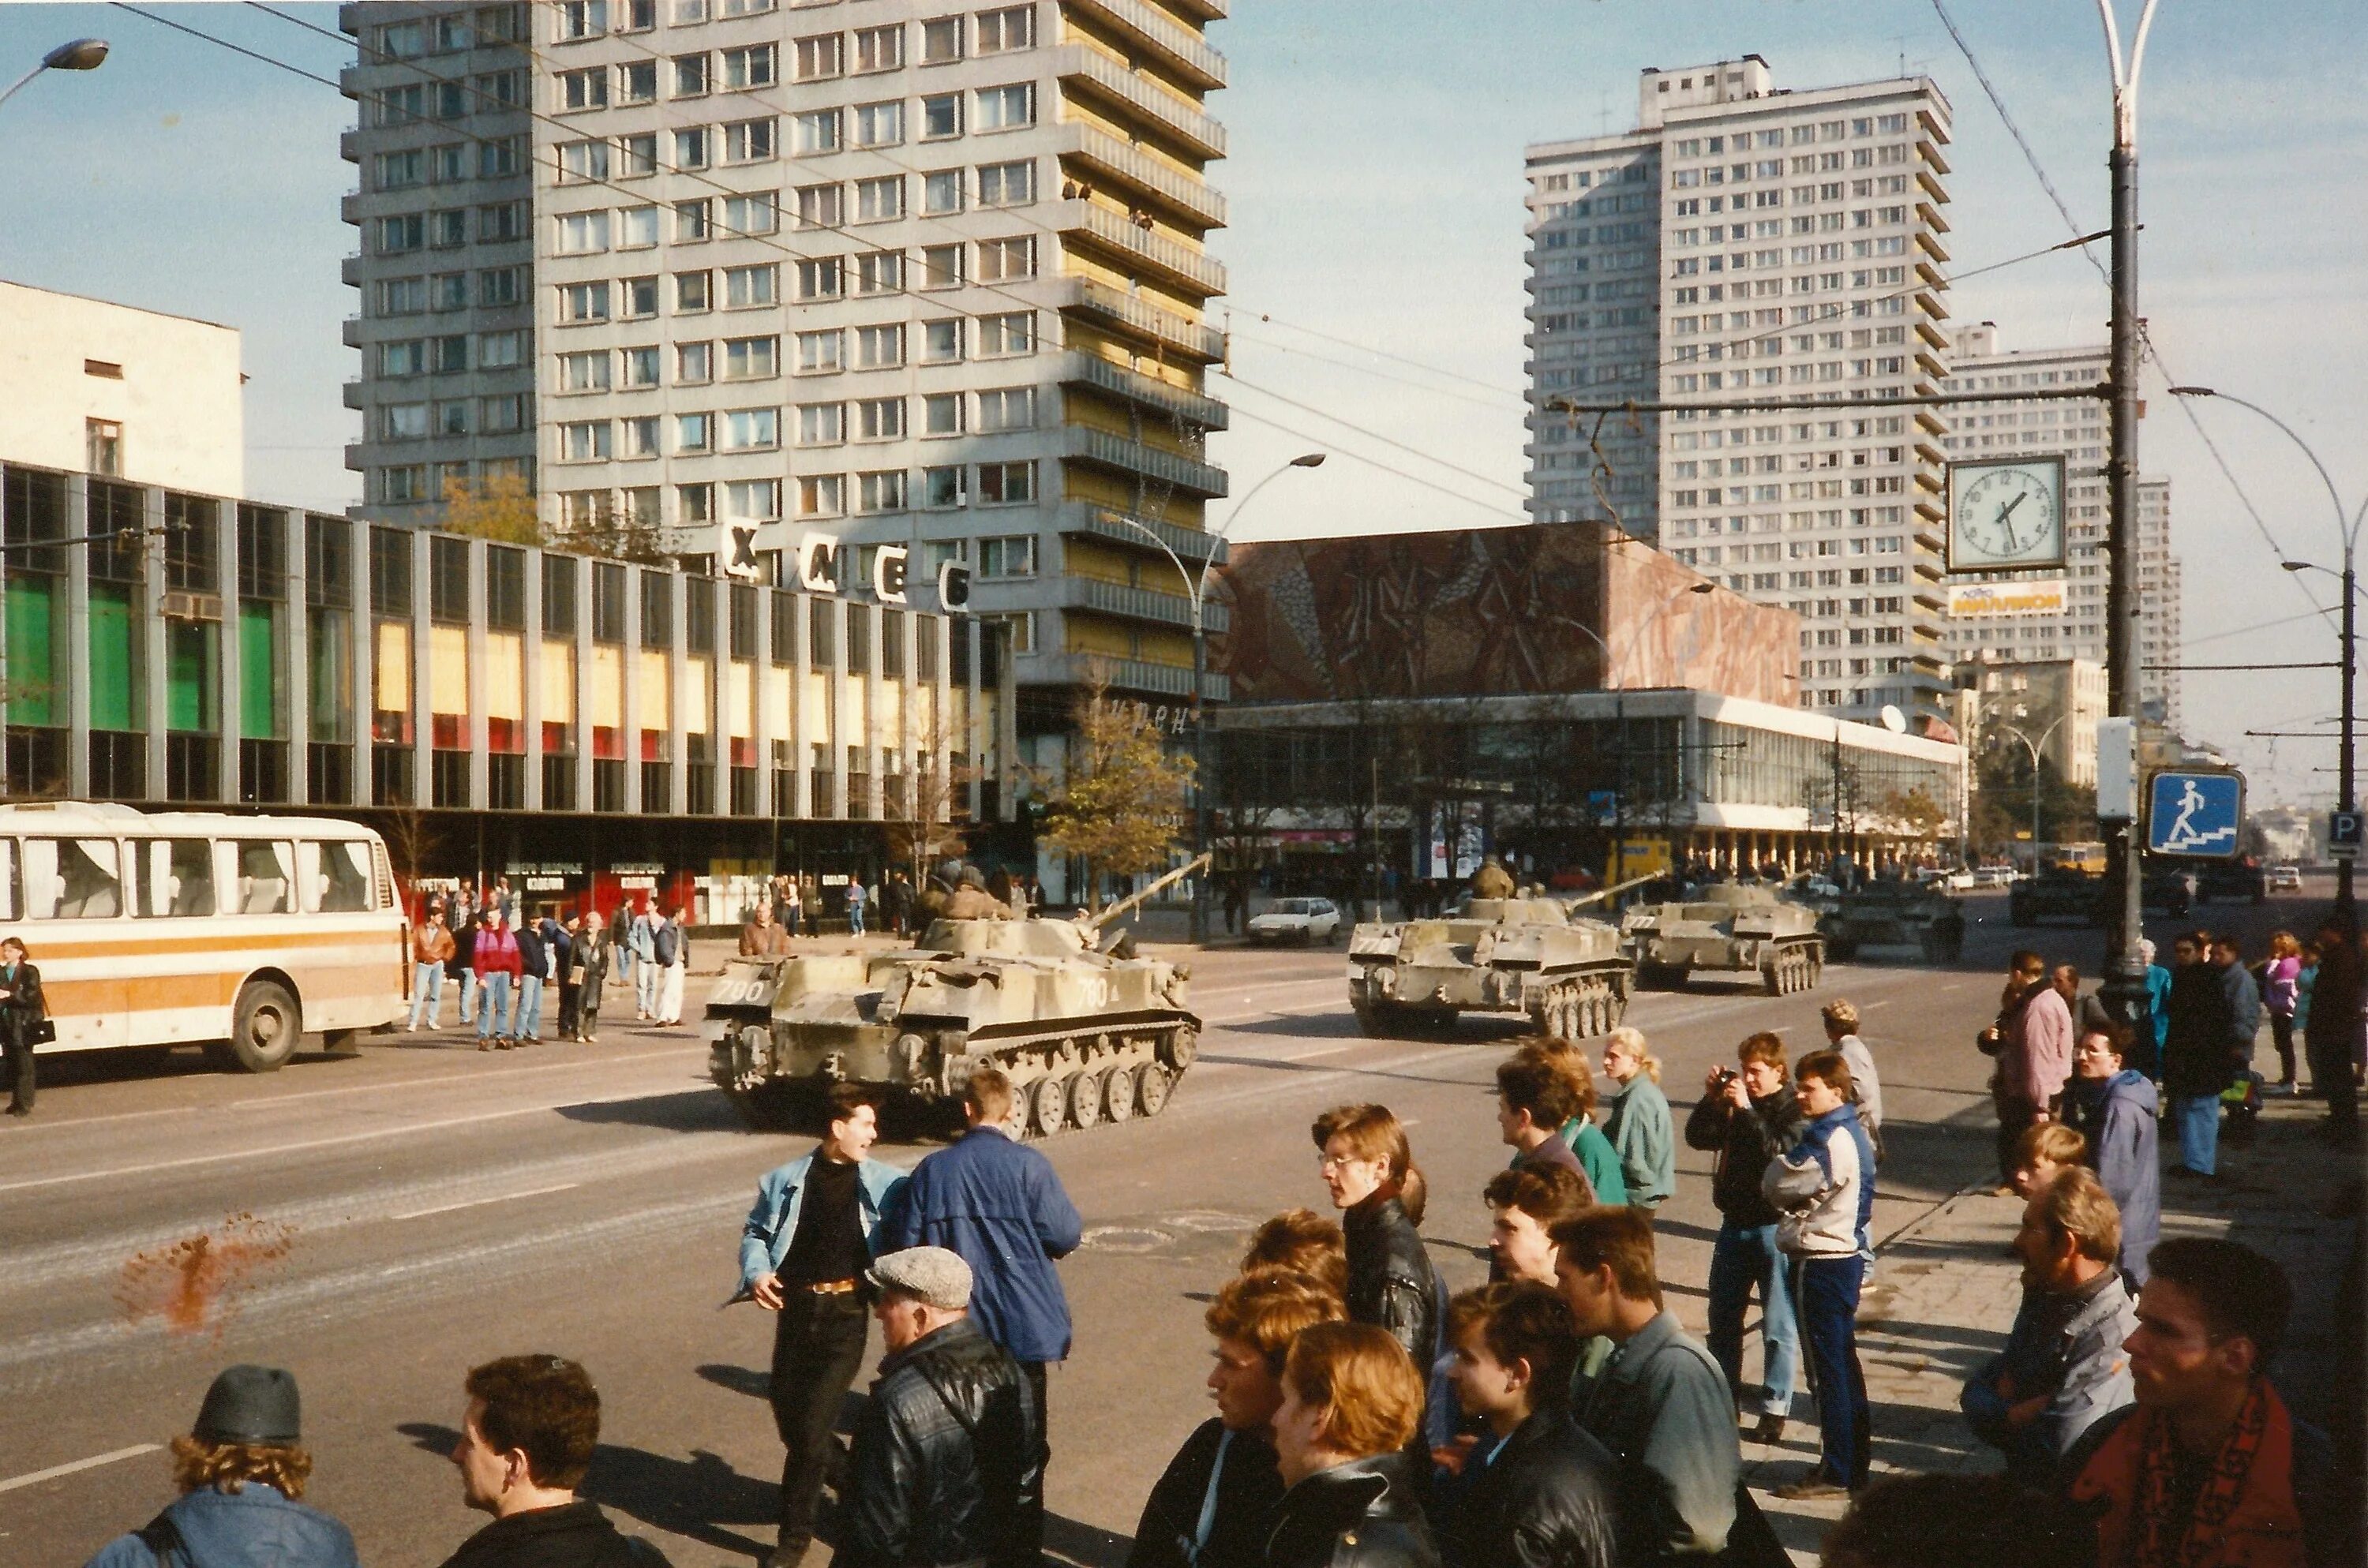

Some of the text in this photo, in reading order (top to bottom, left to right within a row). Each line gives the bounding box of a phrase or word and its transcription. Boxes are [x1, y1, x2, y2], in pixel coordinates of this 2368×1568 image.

[1984, 478, 1991, 490] 11
[2000, 473, 2011, 486] 12
[1970, 491, 1981, 503] 10
[2035, 487, 2044, 500] 2
[1965, 508, 1973, 520] 9
[2040, 505, 2048, 518] 3
[1984, 537, 1991, 550] 7
[2003, 541, 2011, 553] 6
[2336, 815, 2356, 840] P
